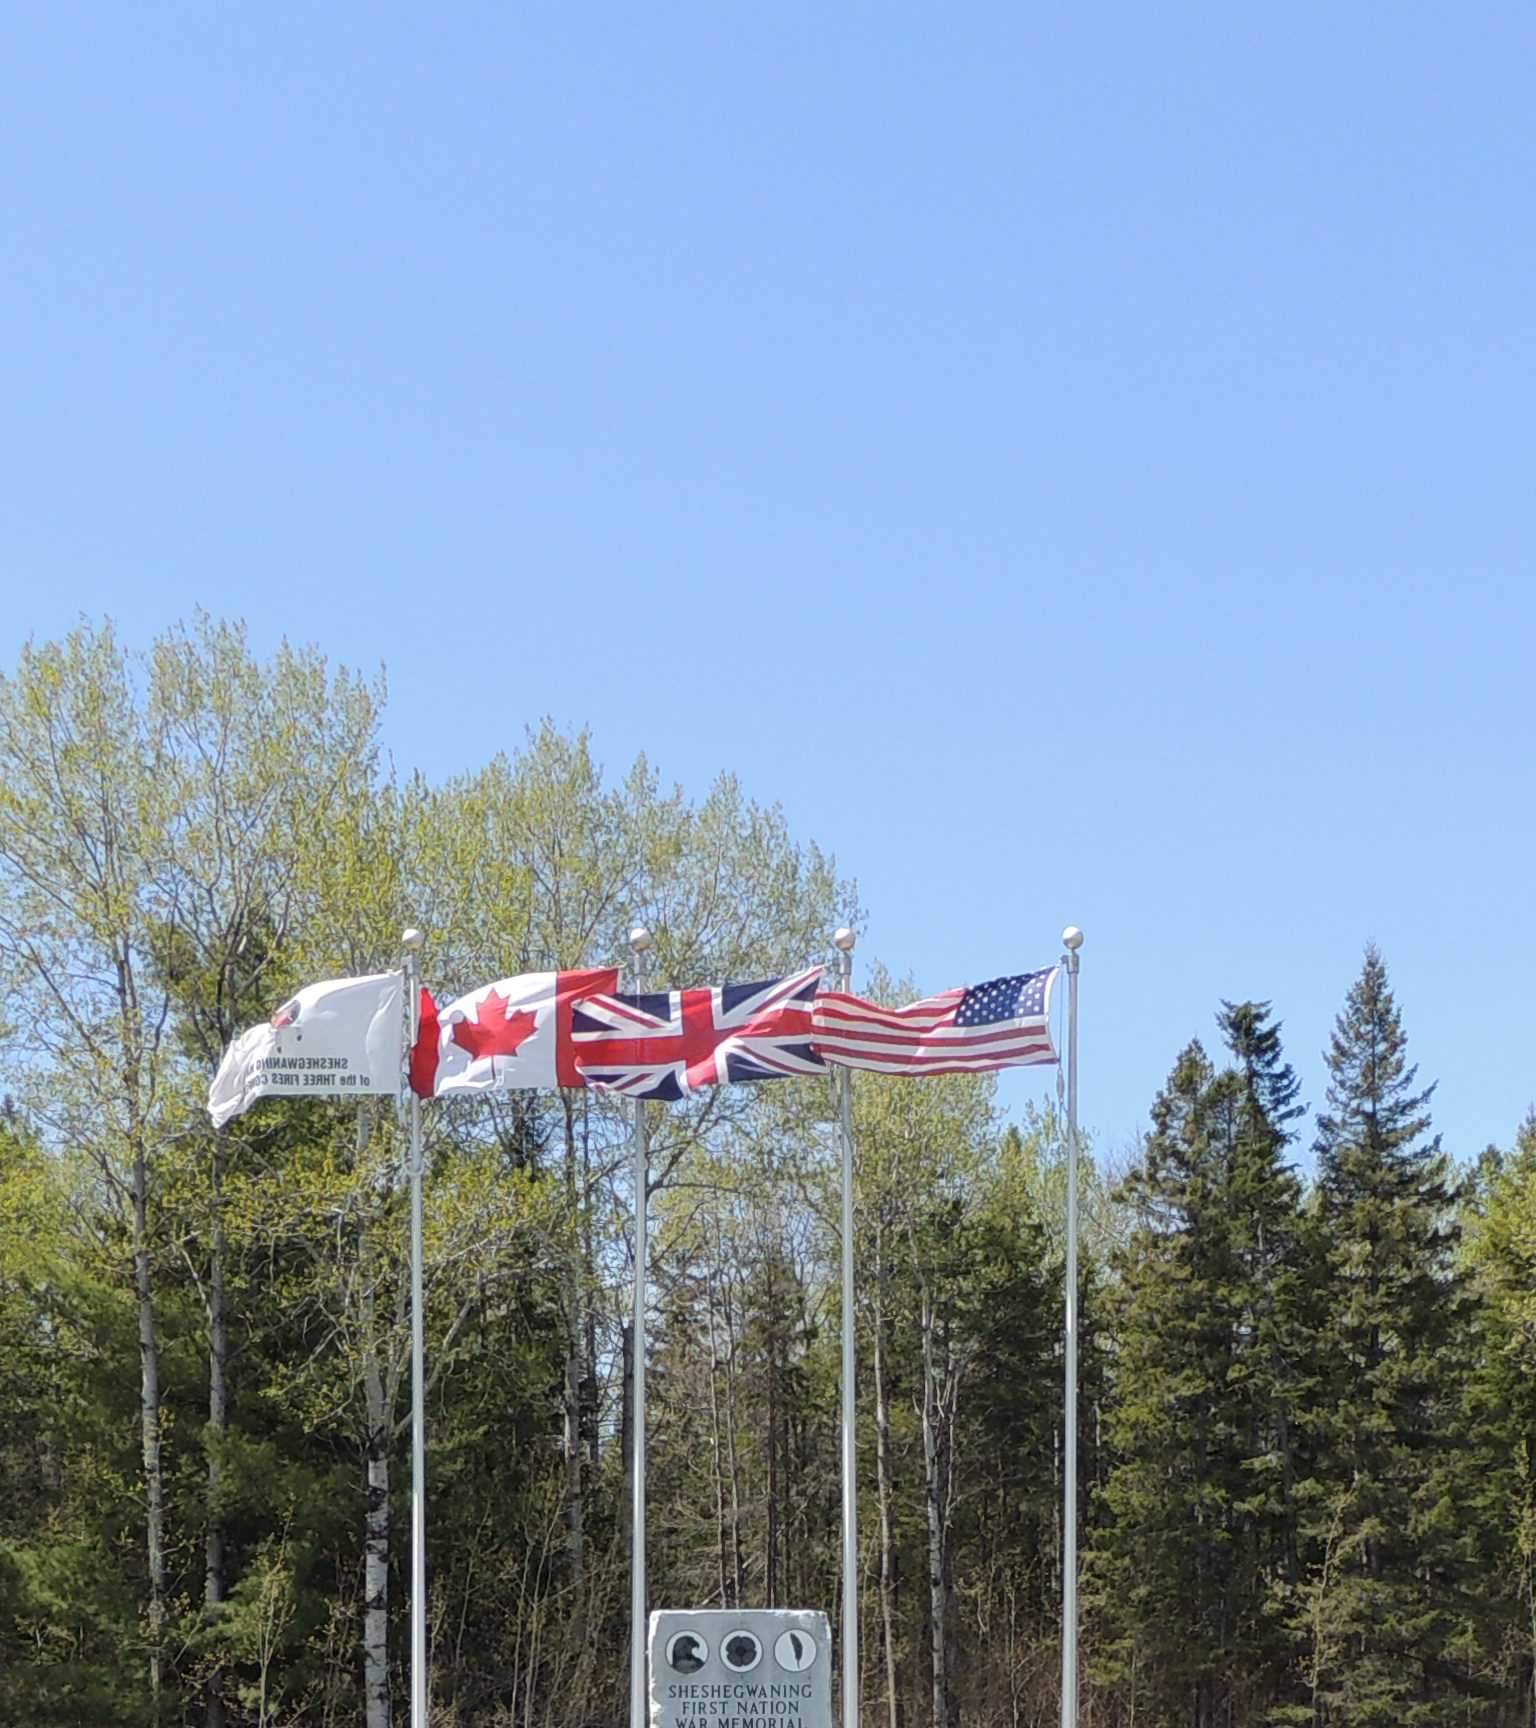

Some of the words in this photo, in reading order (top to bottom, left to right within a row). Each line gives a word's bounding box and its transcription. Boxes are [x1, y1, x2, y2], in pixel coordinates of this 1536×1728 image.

[668, 1684, 812, 1699] SHESHEGWANING
[682, 1701, 728, 1715] FIRST
[737, 1701, 800, 1715] NATION
